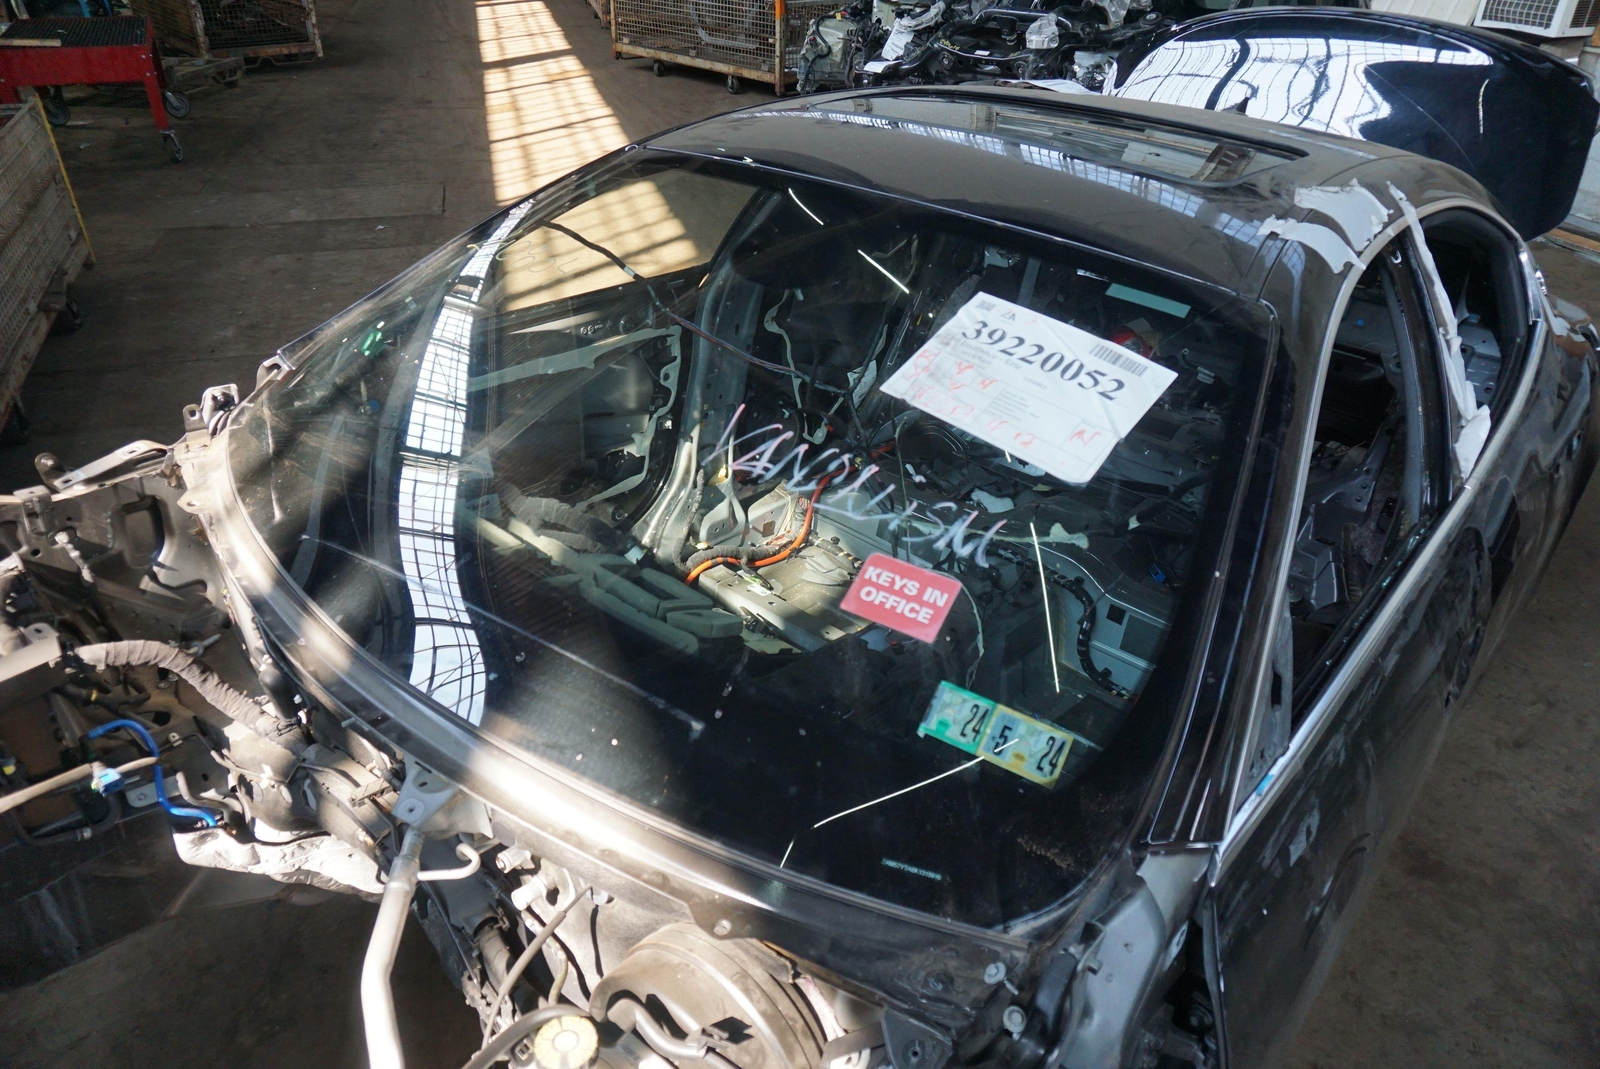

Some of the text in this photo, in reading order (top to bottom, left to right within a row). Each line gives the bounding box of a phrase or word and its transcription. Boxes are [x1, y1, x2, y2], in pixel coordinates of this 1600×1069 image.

[961, 320, 1125, 402] 39220052
[859, 585, 934, 624] OFFICE
[863, 566, 949, 608] KEYS IN
[960, 703, 989, 743] 24
[993, 725, 1067, 778] 5 24
